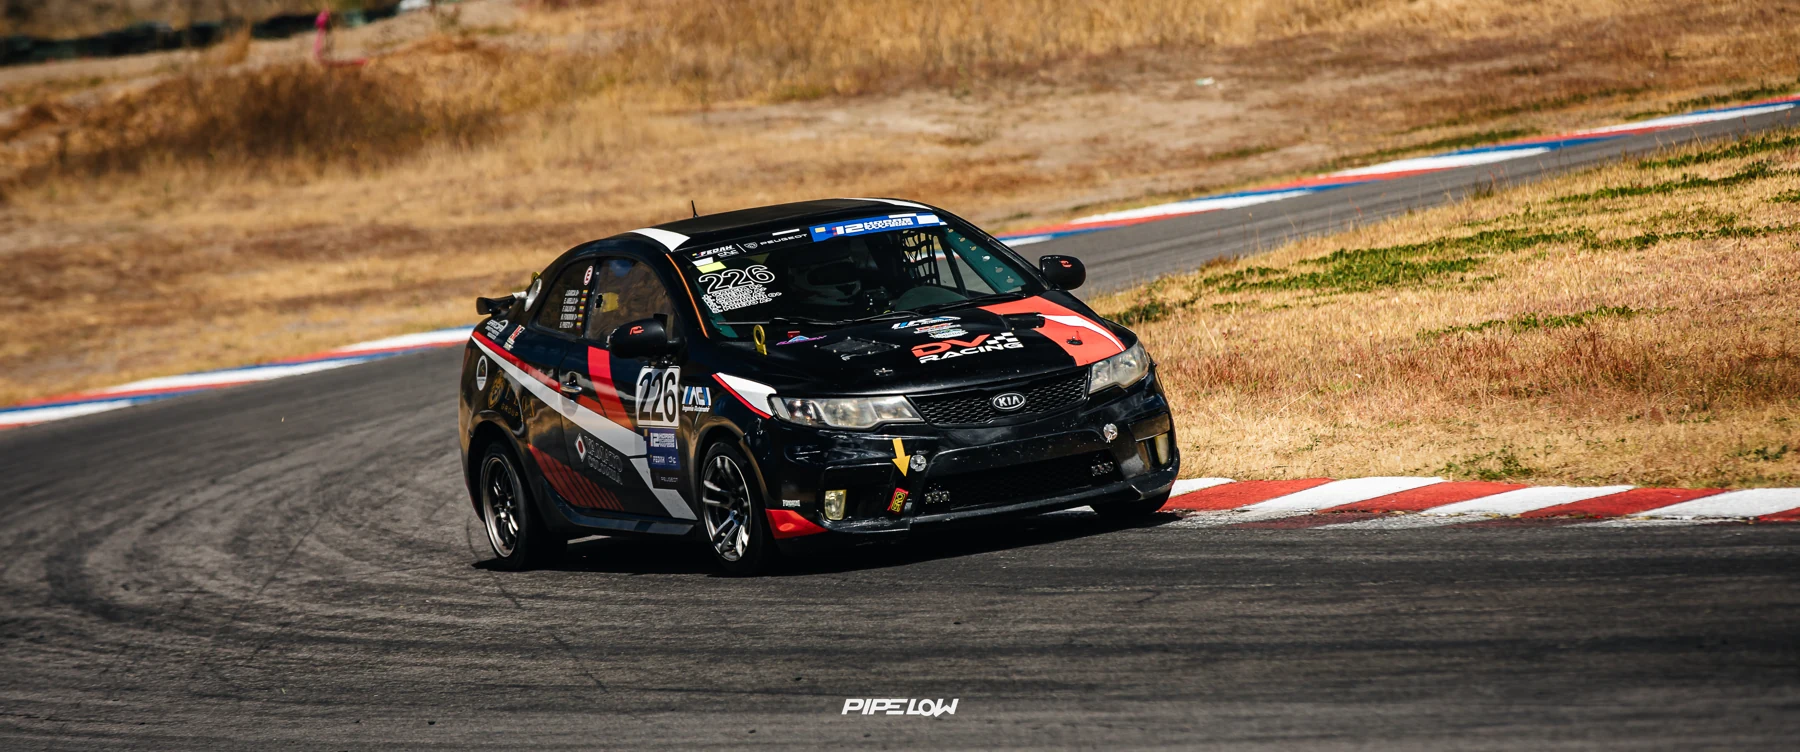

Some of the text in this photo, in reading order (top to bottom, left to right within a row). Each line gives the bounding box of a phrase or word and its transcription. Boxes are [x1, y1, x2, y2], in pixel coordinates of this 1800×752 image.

[760, 233, 807, 245] PEUGEOT
[836, 222, 865, 235] 12
[698, 264, 776, 294] 226
[911, 334, 990, 358] DV
[919, 342, 1024, 364] RACING
[638, 371, 677, 423] 226
[998, 395, 1020, 407] KIA
